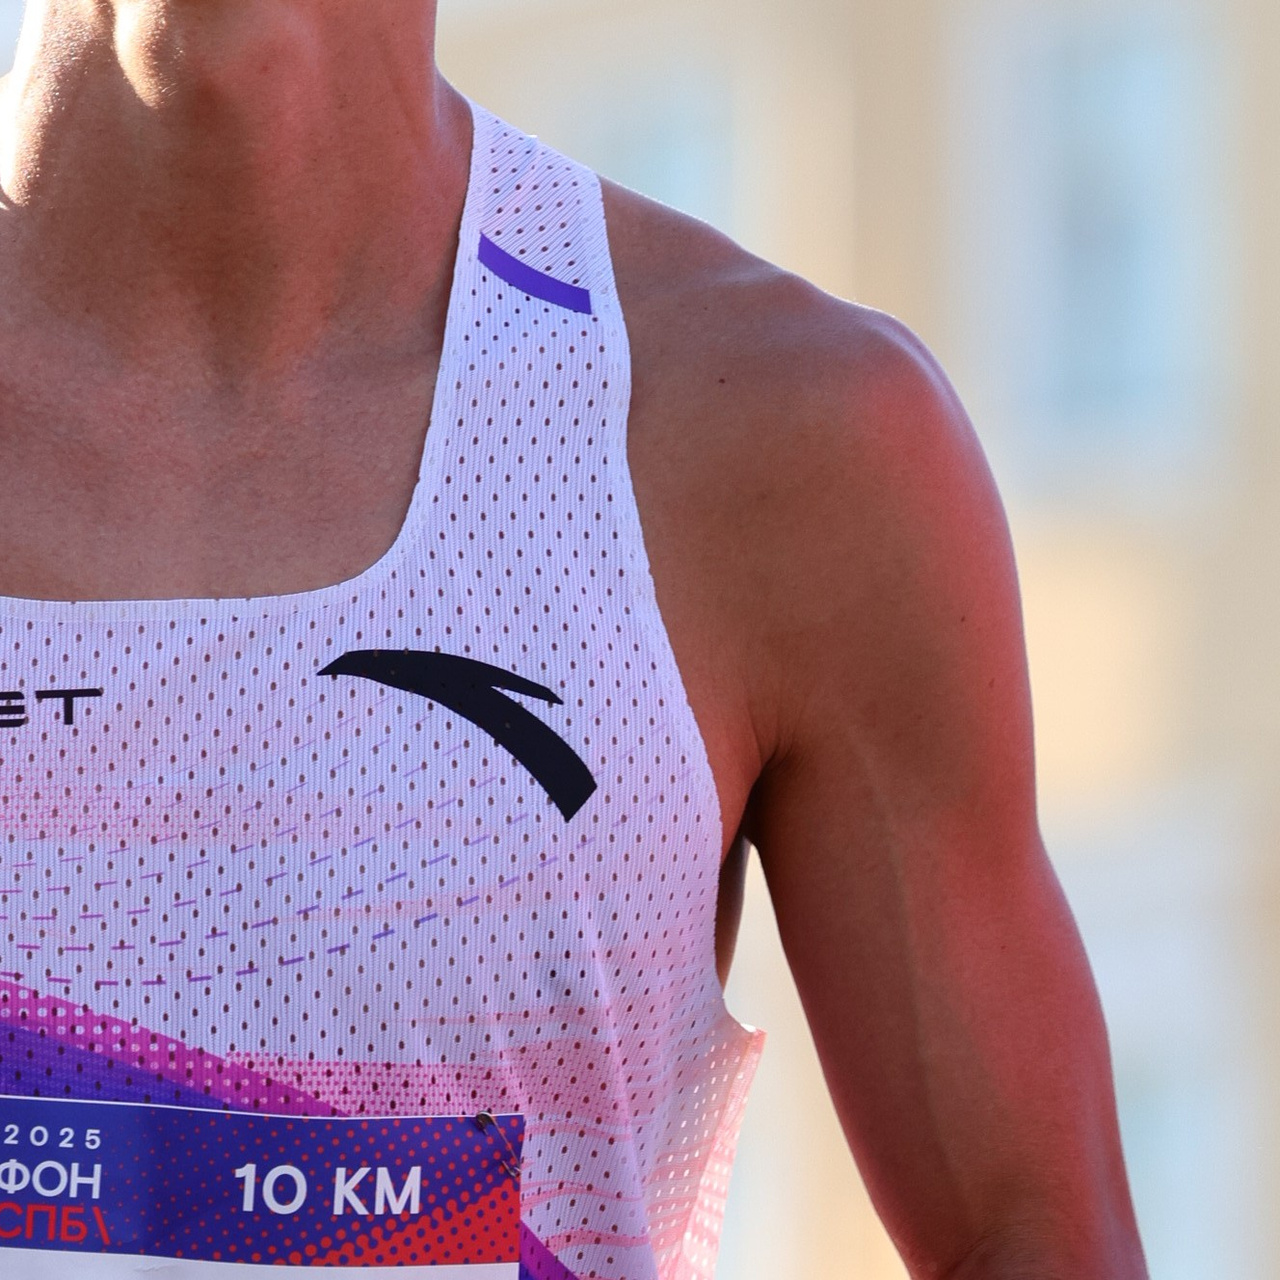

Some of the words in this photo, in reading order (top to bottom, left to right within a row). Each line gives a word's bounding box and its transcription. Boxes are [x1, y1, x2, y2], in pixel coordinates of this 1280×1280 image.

[3, 1124, 101, 1150] 2025
[234, 1164, 308, 1216] 10
[333, 1165, 423, 1216] КМ
